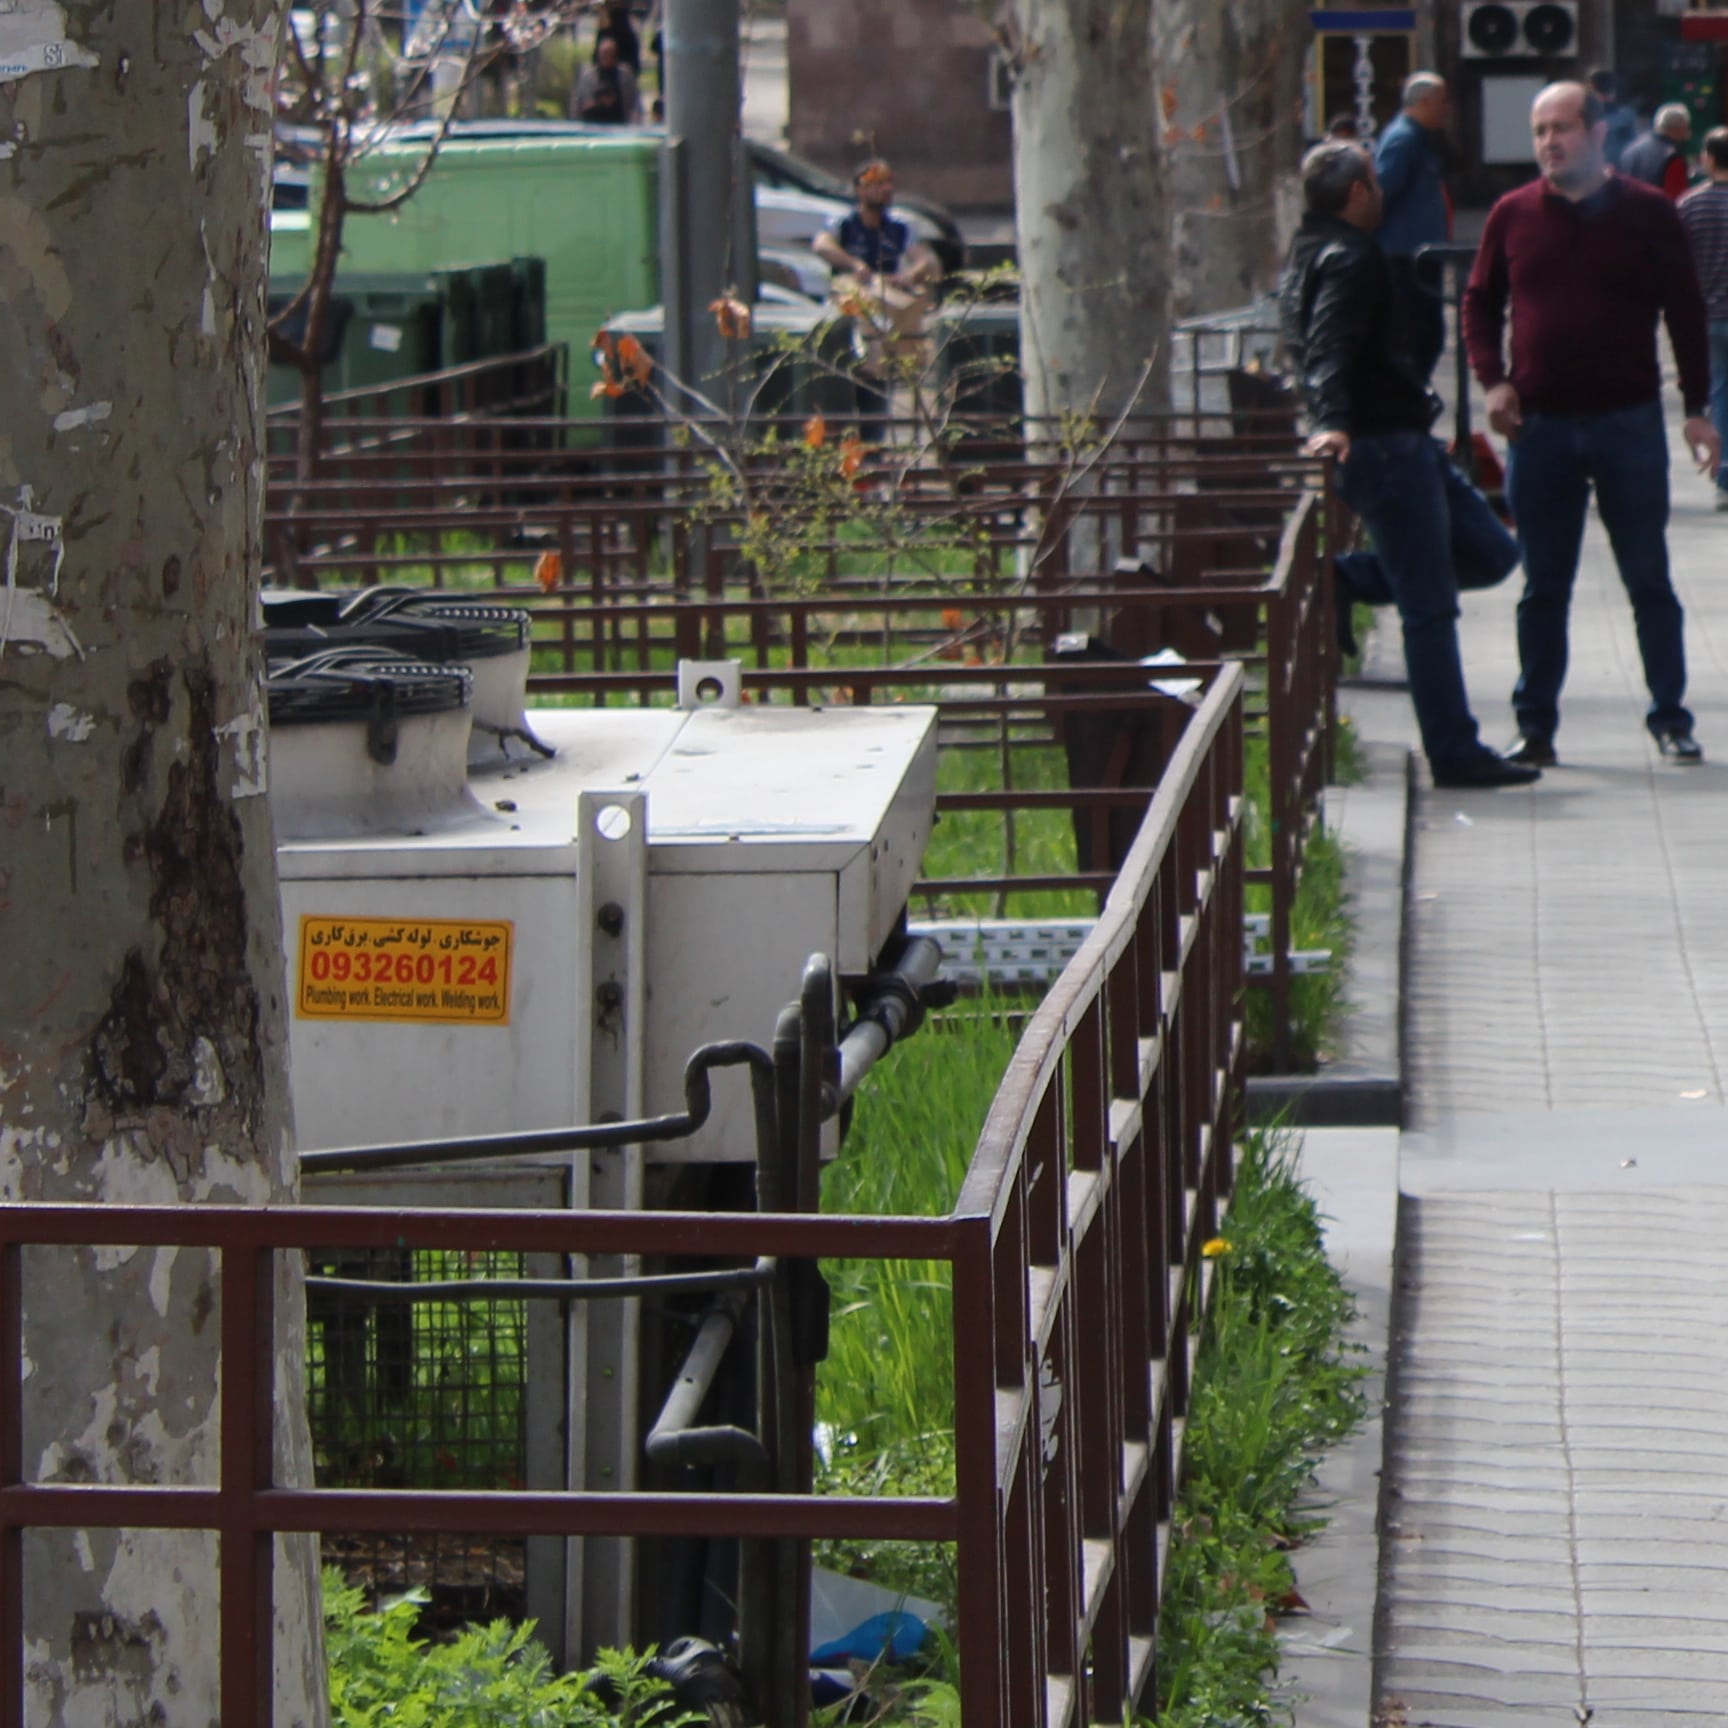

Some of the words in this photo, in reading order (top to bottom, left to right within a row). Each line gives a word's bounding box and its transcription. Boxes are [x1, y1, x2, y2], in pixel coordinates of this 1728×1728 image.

[310, 950, 498, 986] 093260124
[306, 984, 347, 1010] Plumbing
[374, 986, 415, 1007] Electrical
[441, 988, 476, 1014] Welding
